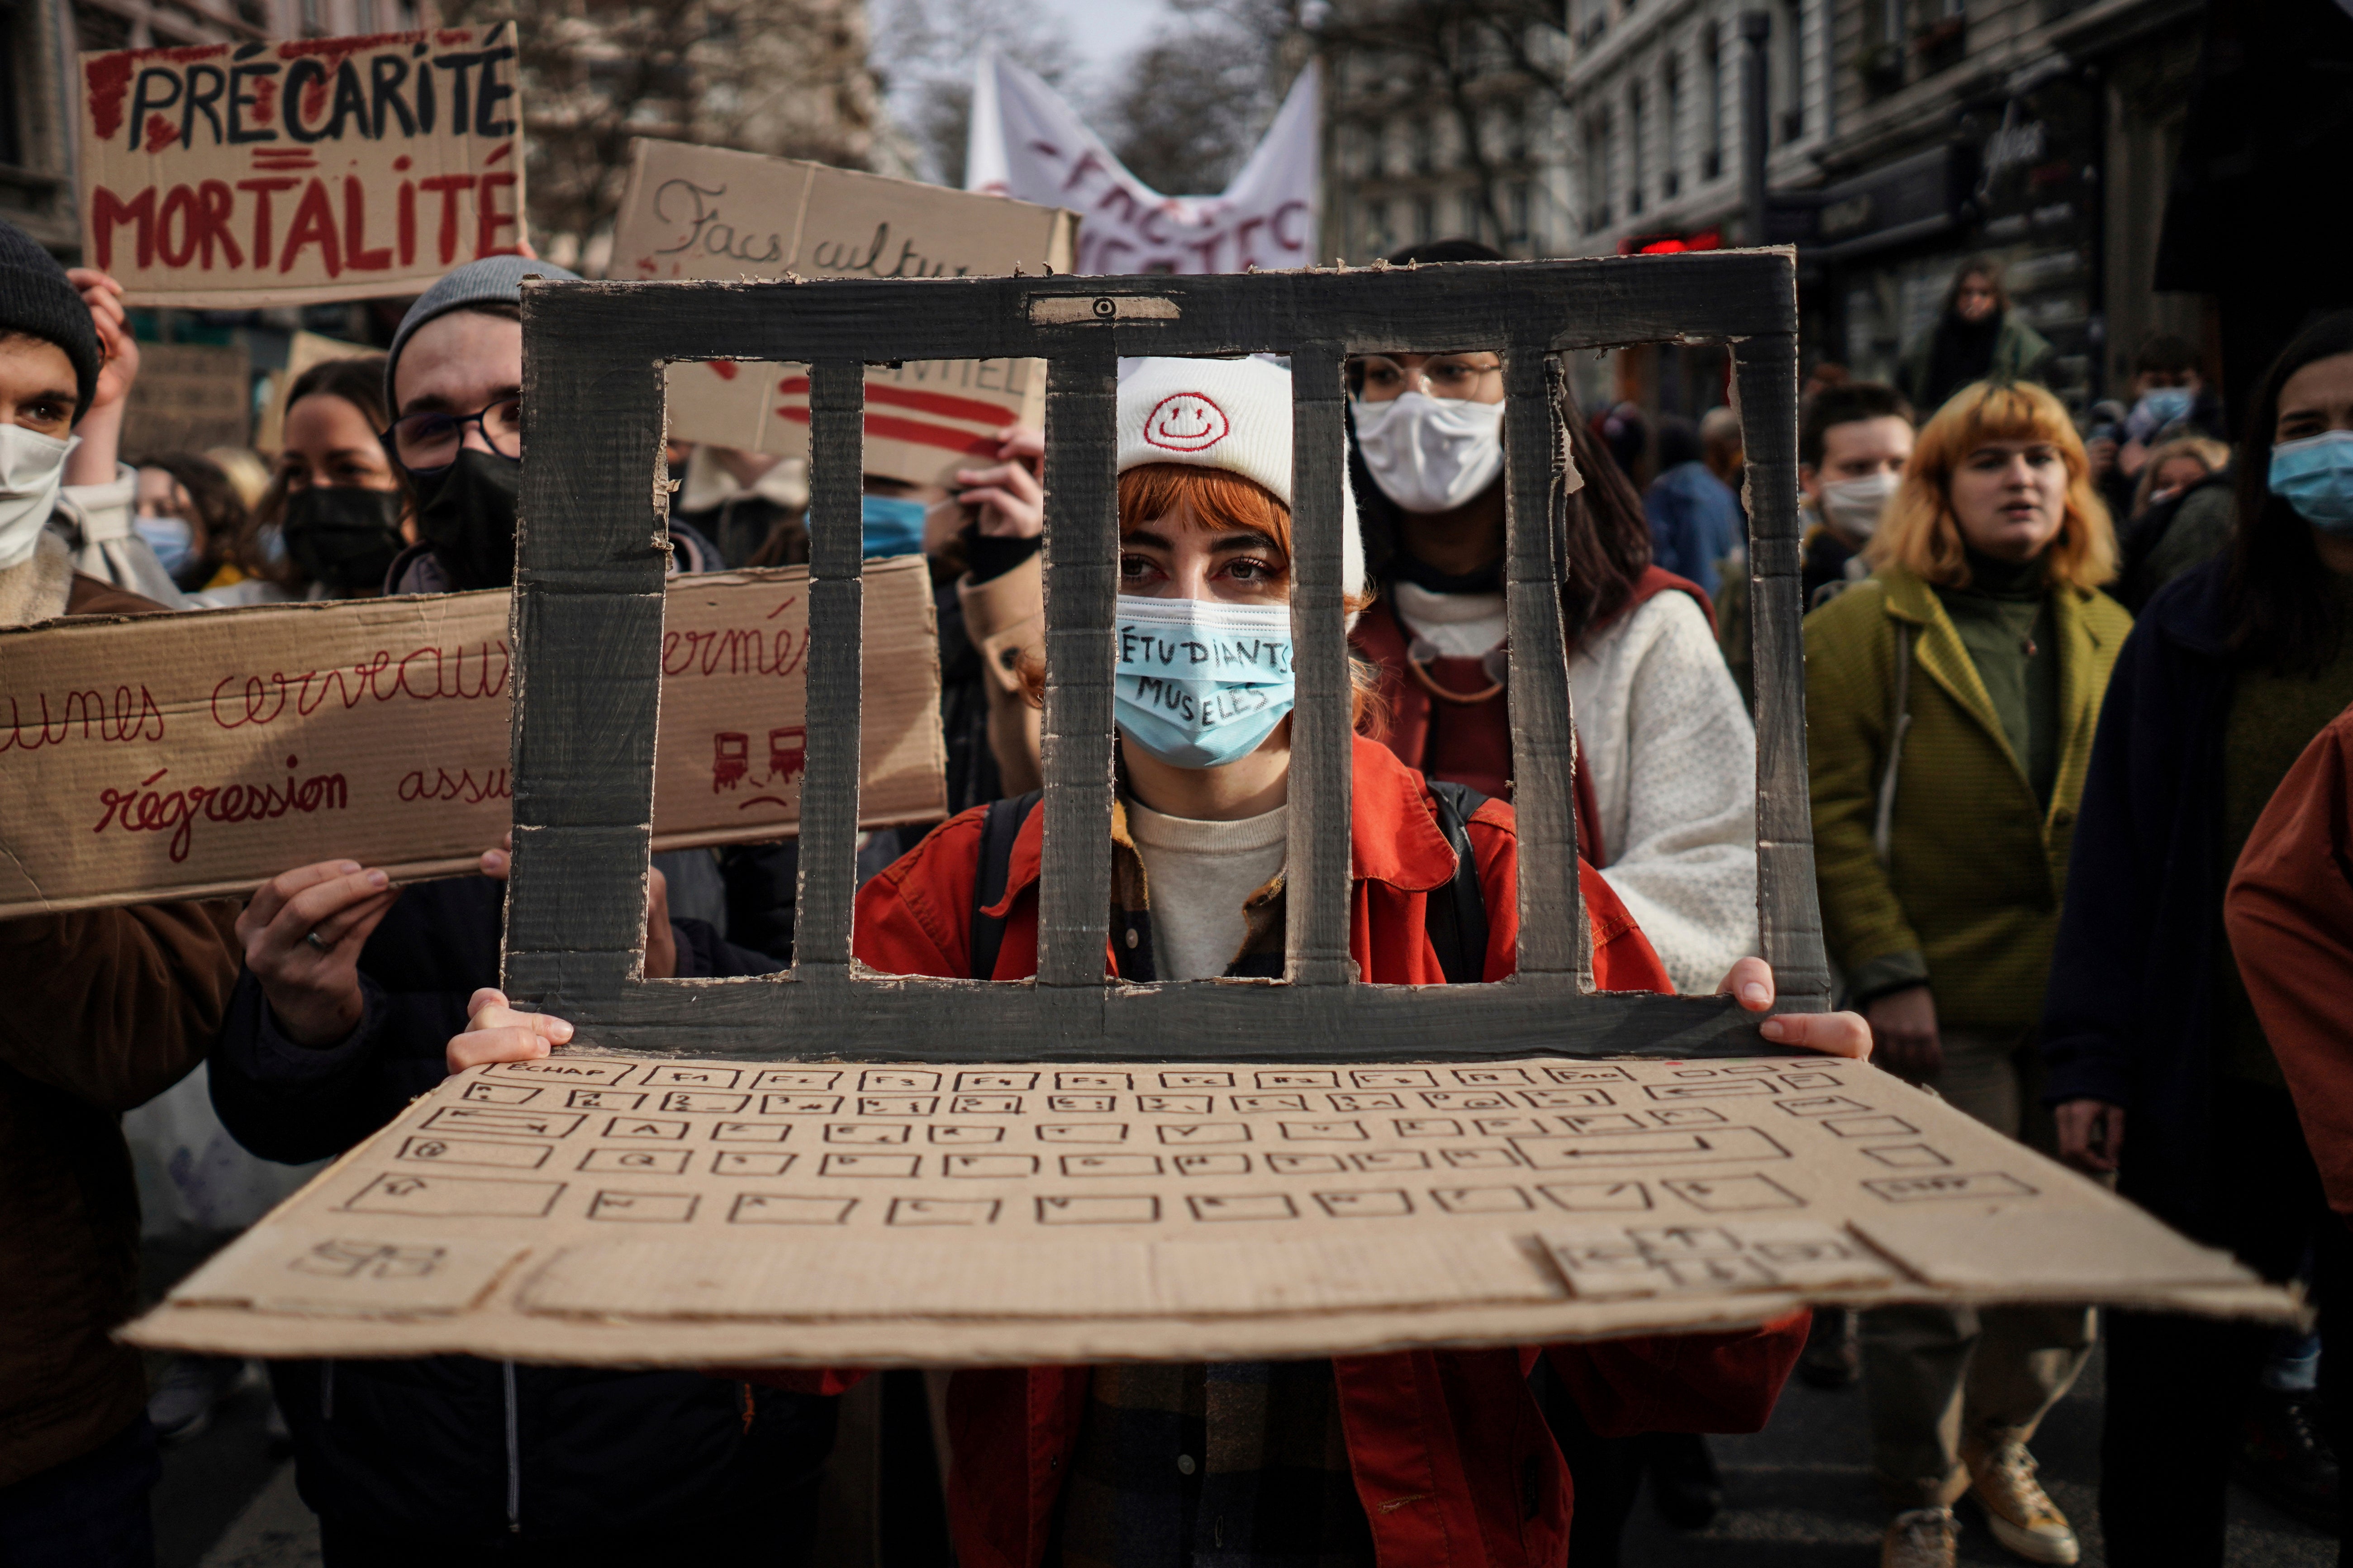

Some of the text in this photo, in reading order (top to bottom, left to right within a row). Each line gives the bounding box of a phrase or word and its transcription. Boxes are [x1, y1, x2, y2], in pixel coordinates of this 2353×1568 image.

[128, 23, 516, 150] PRÉCARITÉ
[93, 141, 518, 278] MORTALITÉ
[0, 685, 163, 753] unes
[662, 596, 809, 676] ermé
[1121, 626, 1288, 674] ÉTUDIANTS
[93, 754, 513, 862] régression assu
[506, 1061, 607, 1076] ÉCHAP
[670, 1073, 709, 1082] F1
[768, 1075, 814, 1083] F2
[874, 1076, 916, 1086] F3
[631, 1124, 660, 1135] A
